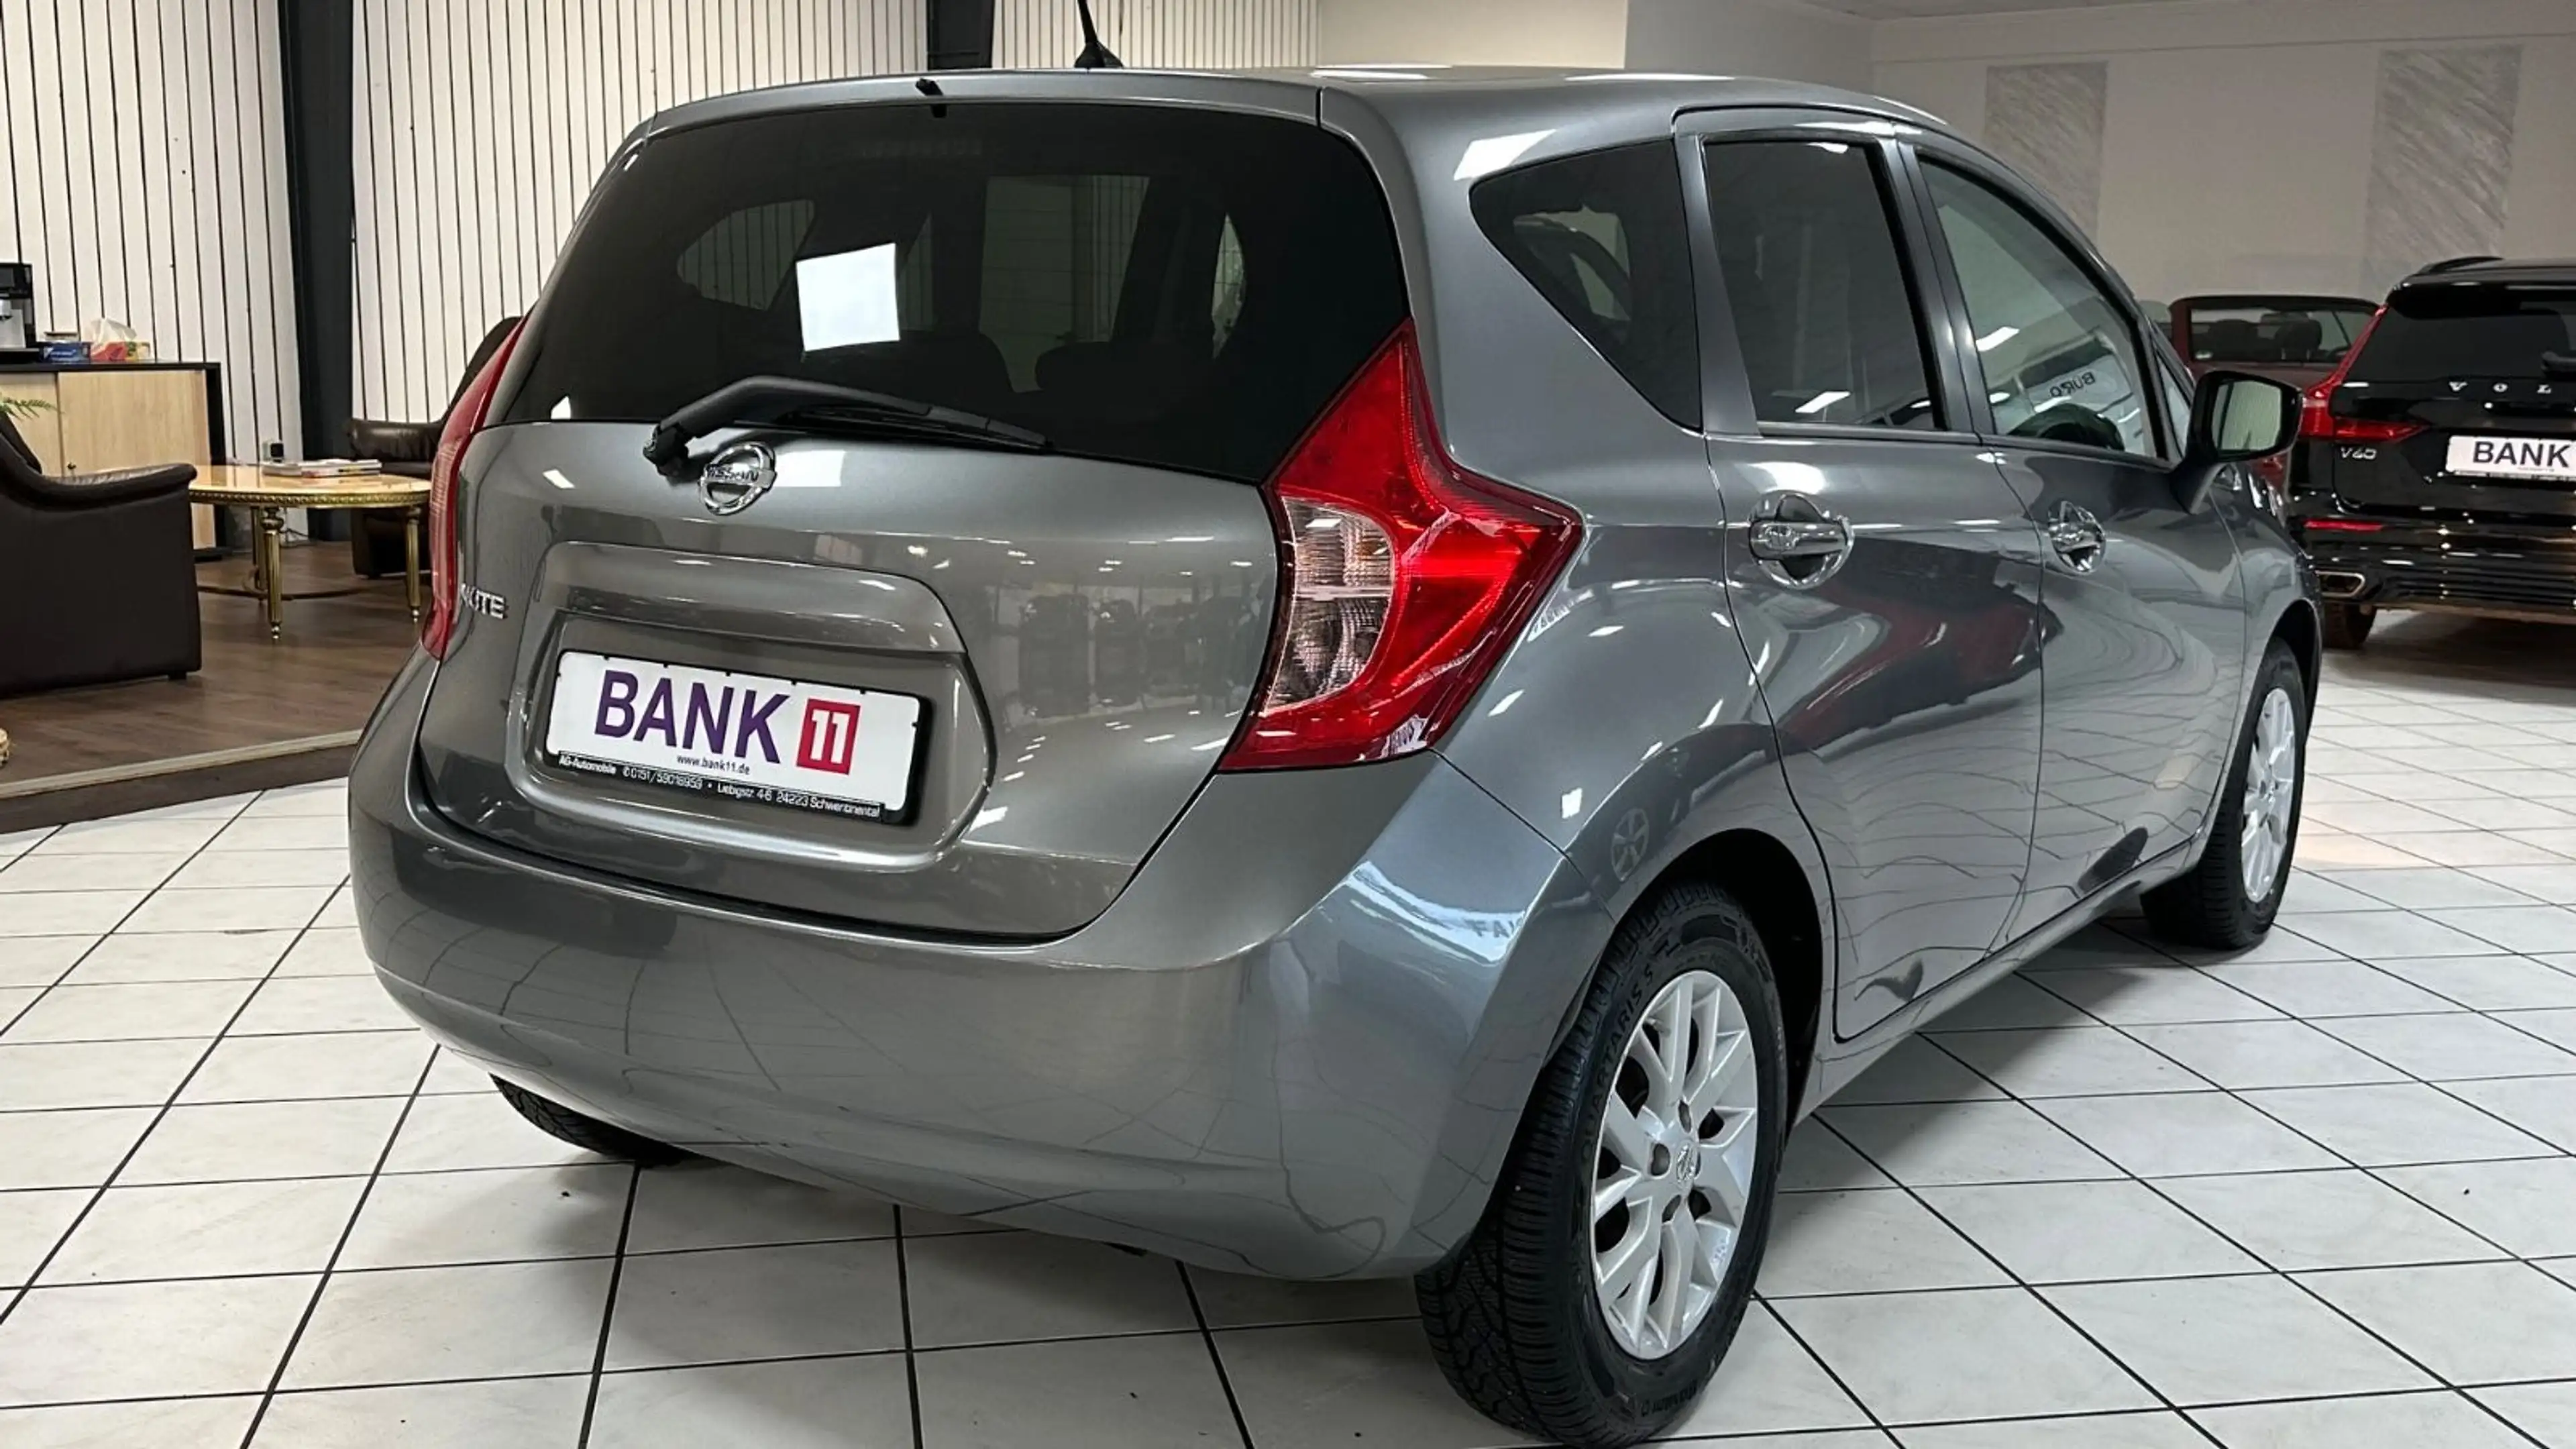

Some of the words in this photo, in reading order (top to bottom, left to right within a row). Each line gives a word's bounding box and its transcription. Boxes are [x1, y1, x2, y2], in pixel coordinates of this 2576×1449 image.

[2340, 445, 2377, 460] V60
[2473, 440, 2570, 468] BANK
[594, 669, 790, 764] BANK
[808, 707, 853, 765] 11
[676, 755, 750, 775] www.bank11.de
[775, 790, 809, 808] 24223
